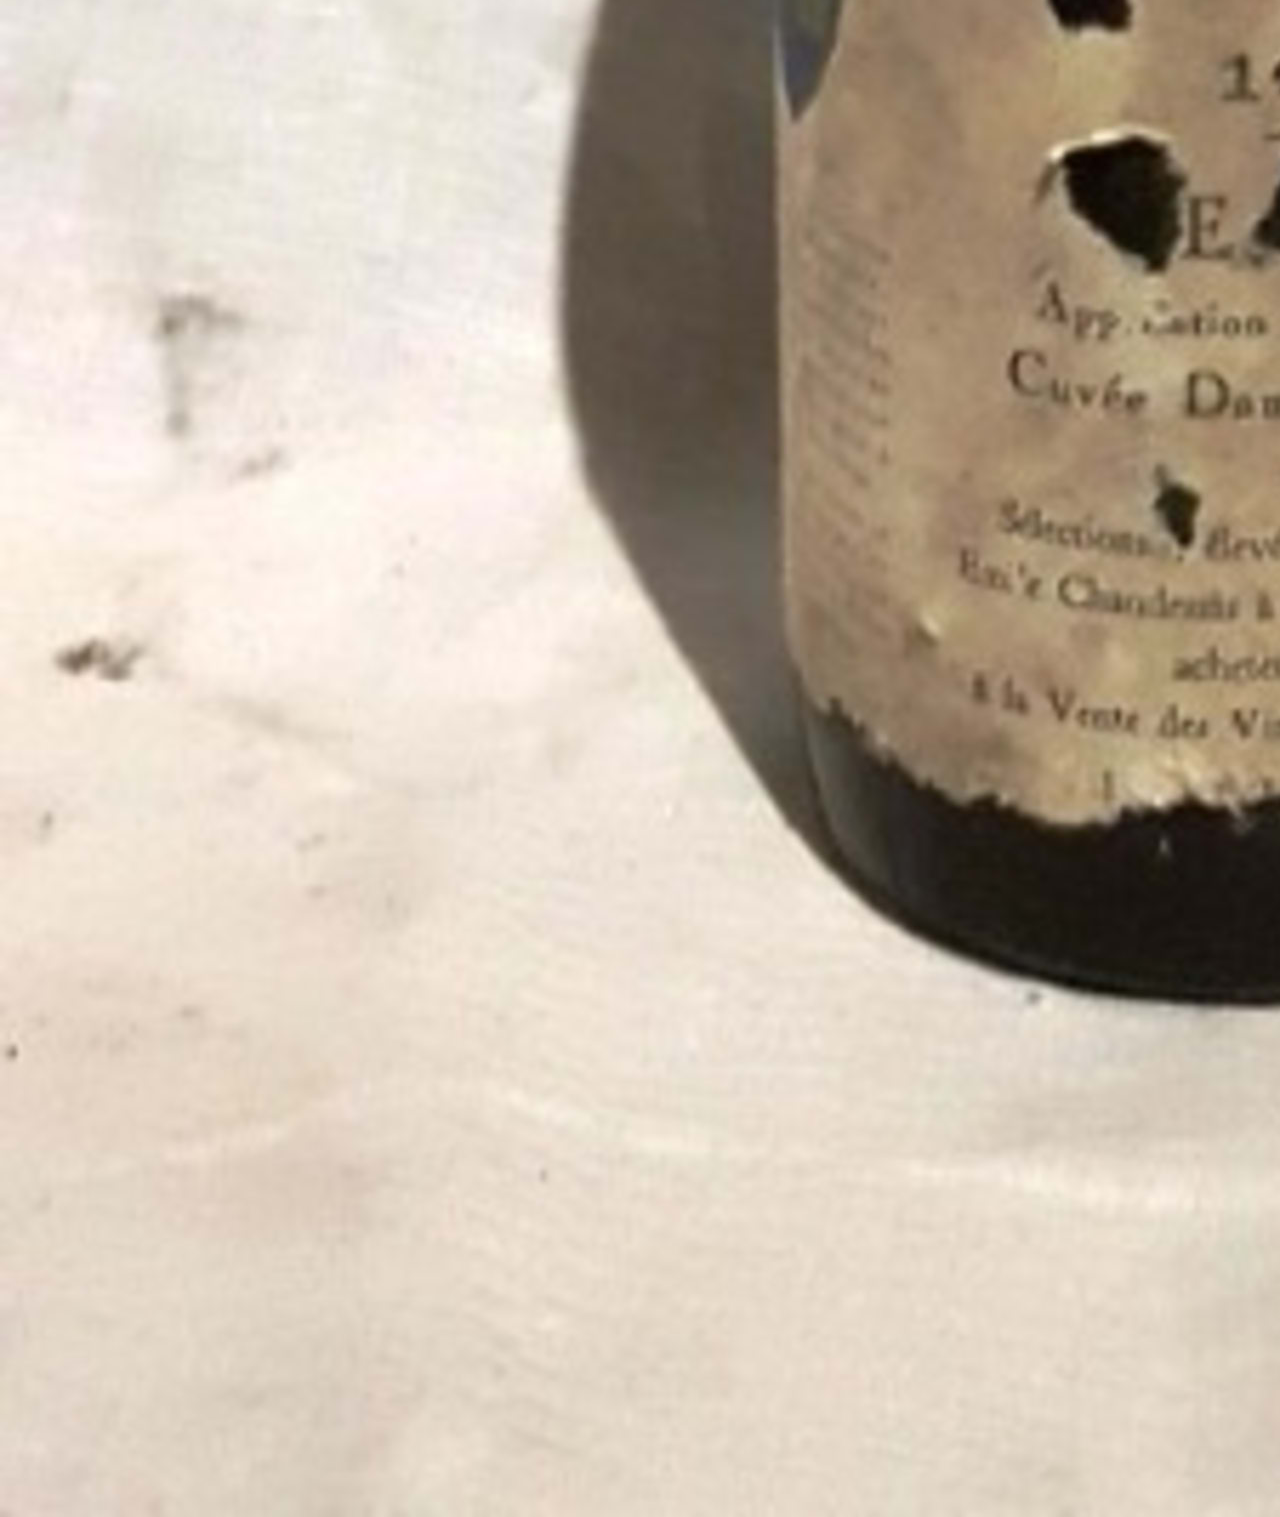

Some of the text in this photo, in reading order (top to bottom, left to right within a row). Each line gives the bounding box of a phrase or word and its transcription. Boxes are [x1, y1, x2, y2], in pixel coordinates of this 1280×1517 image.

[1006, 349, 1148, 412] Cuvée
[1002, 675, 1029, 714] la
[1048, 686, 1138, 734] Vente
[1158, 703, 1208, 738] des
